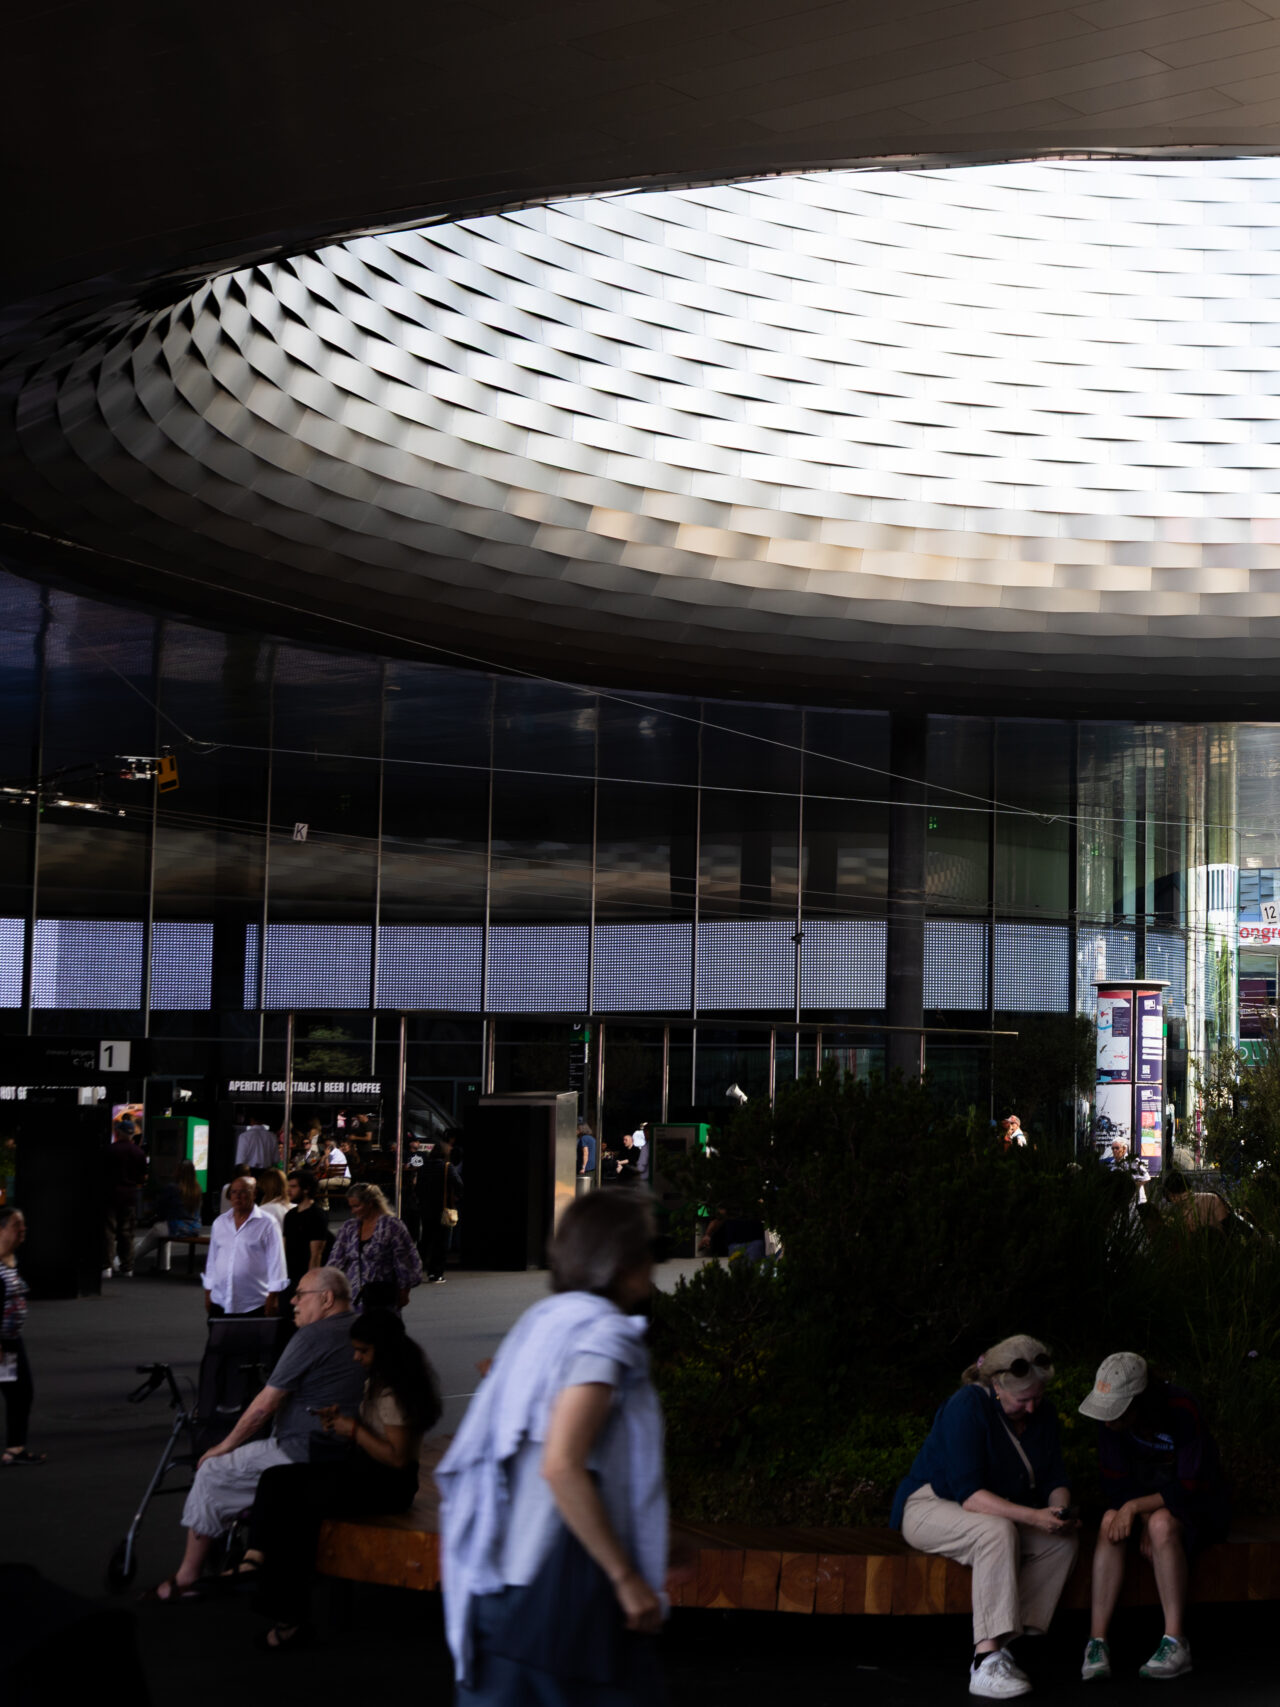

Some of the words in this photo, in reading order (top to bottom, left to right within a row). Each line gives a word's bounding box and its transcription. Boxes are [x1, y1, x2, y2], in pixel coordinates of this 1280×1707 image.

[296, 824, 306, 840] K
[1264, 906, 1277, 919] 12
[103, 1045, 114, 1068] 1
[228, 1080, 265, 1092] APERITIF
[271, 1081, 316, 1093] COCTAILS
[323, 1081, 345, 1093] BEER
[351, 1082, 381, 1094] COFFEE
